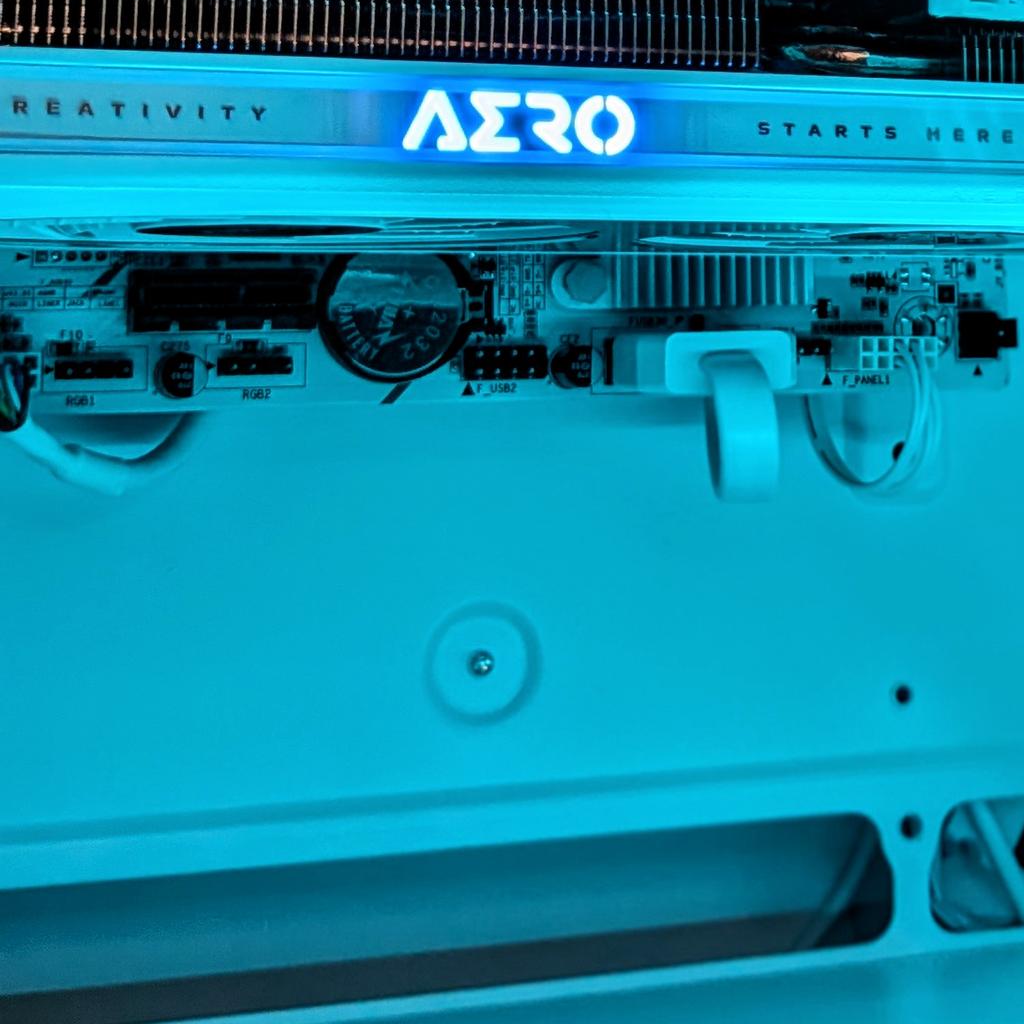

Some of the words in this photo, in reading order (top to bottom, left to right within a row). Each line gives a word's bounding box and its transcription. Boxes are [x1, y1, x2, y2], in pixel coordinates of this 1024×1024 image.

[12, 95, 268, 122] REATIVITY
[402, 89, 637, 157] AERO
[758, 121, 898, 141] STARTS
[242, 388, 272, 401] RGB2
[476, 383, 518, 396] F_USB2
[65, 394, 96, 407] RGB1
